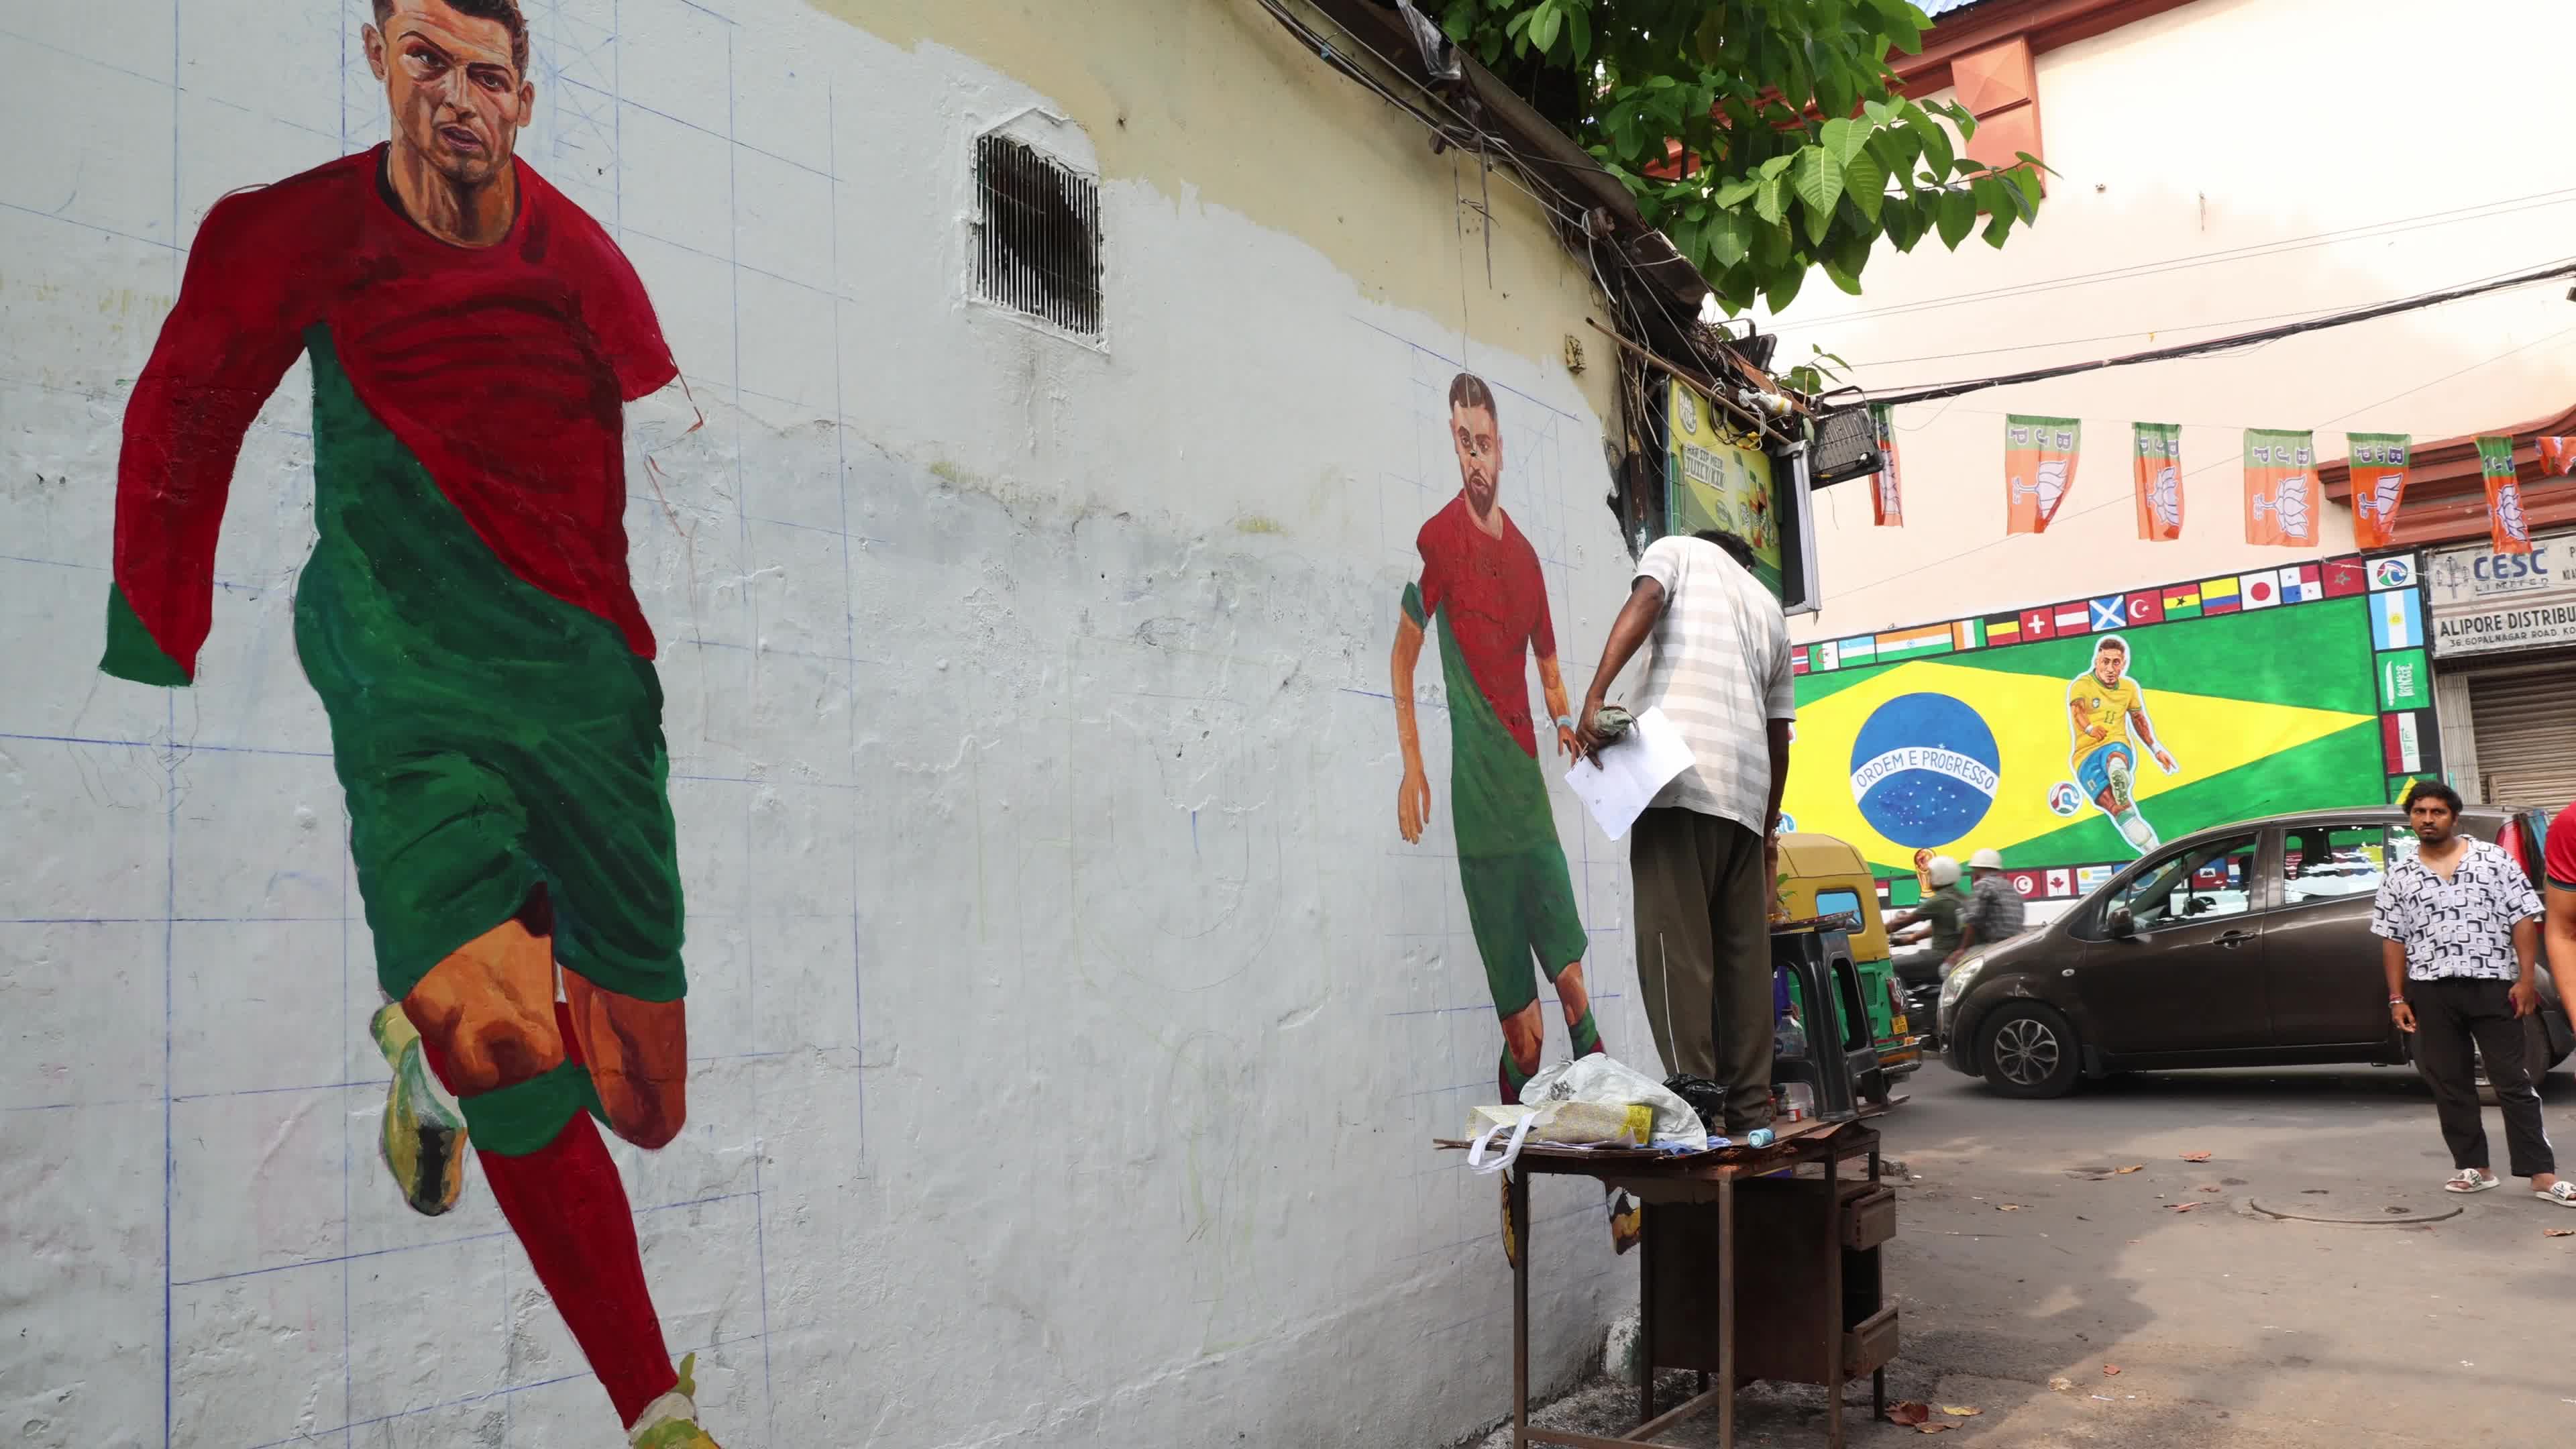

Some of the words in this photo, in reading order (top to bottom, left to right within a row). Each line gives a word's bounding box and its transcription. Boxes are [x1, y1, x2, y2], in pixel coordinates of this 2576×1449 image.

[2010, 427, 2072, 450] BJP
[2253, 446, 2310, 466] BJP
[2474, 549, 2548, 581] CESC
[2475, 578, 2549, 592] LIMITED
[2440, 614, 2502, 637] ALIPORE
[1856, 753, 1904, 788] ORDEM
[1909, 750, 1917, 765] E
[1923, 750, 1994, 790] PROGRESSO
